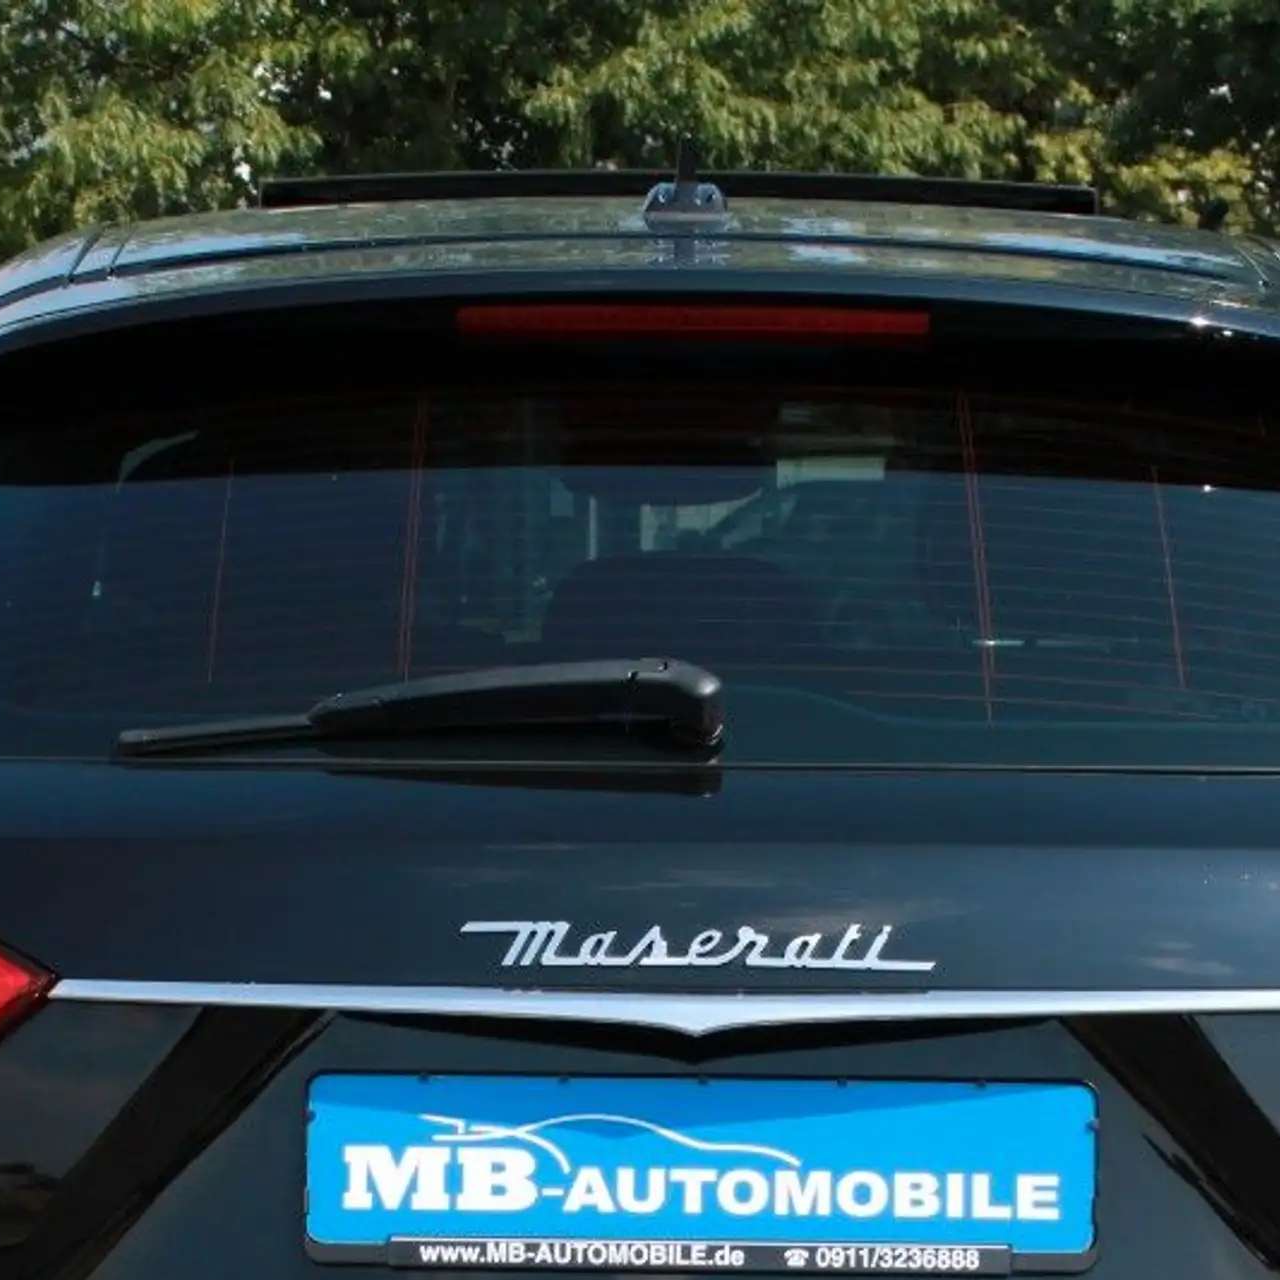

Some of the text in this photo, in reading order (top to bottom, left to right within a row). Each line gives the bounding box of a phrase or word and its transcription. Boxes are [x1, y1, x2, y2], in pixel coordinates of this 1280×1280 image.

[460, 920, 936, 971] Maserati
[342, 1144, 1060, 1221] MB-AUTOMOBILE
[419, 1242, 980, 1270] www.MB-AUTOMOBILE.de 0911/3236888
